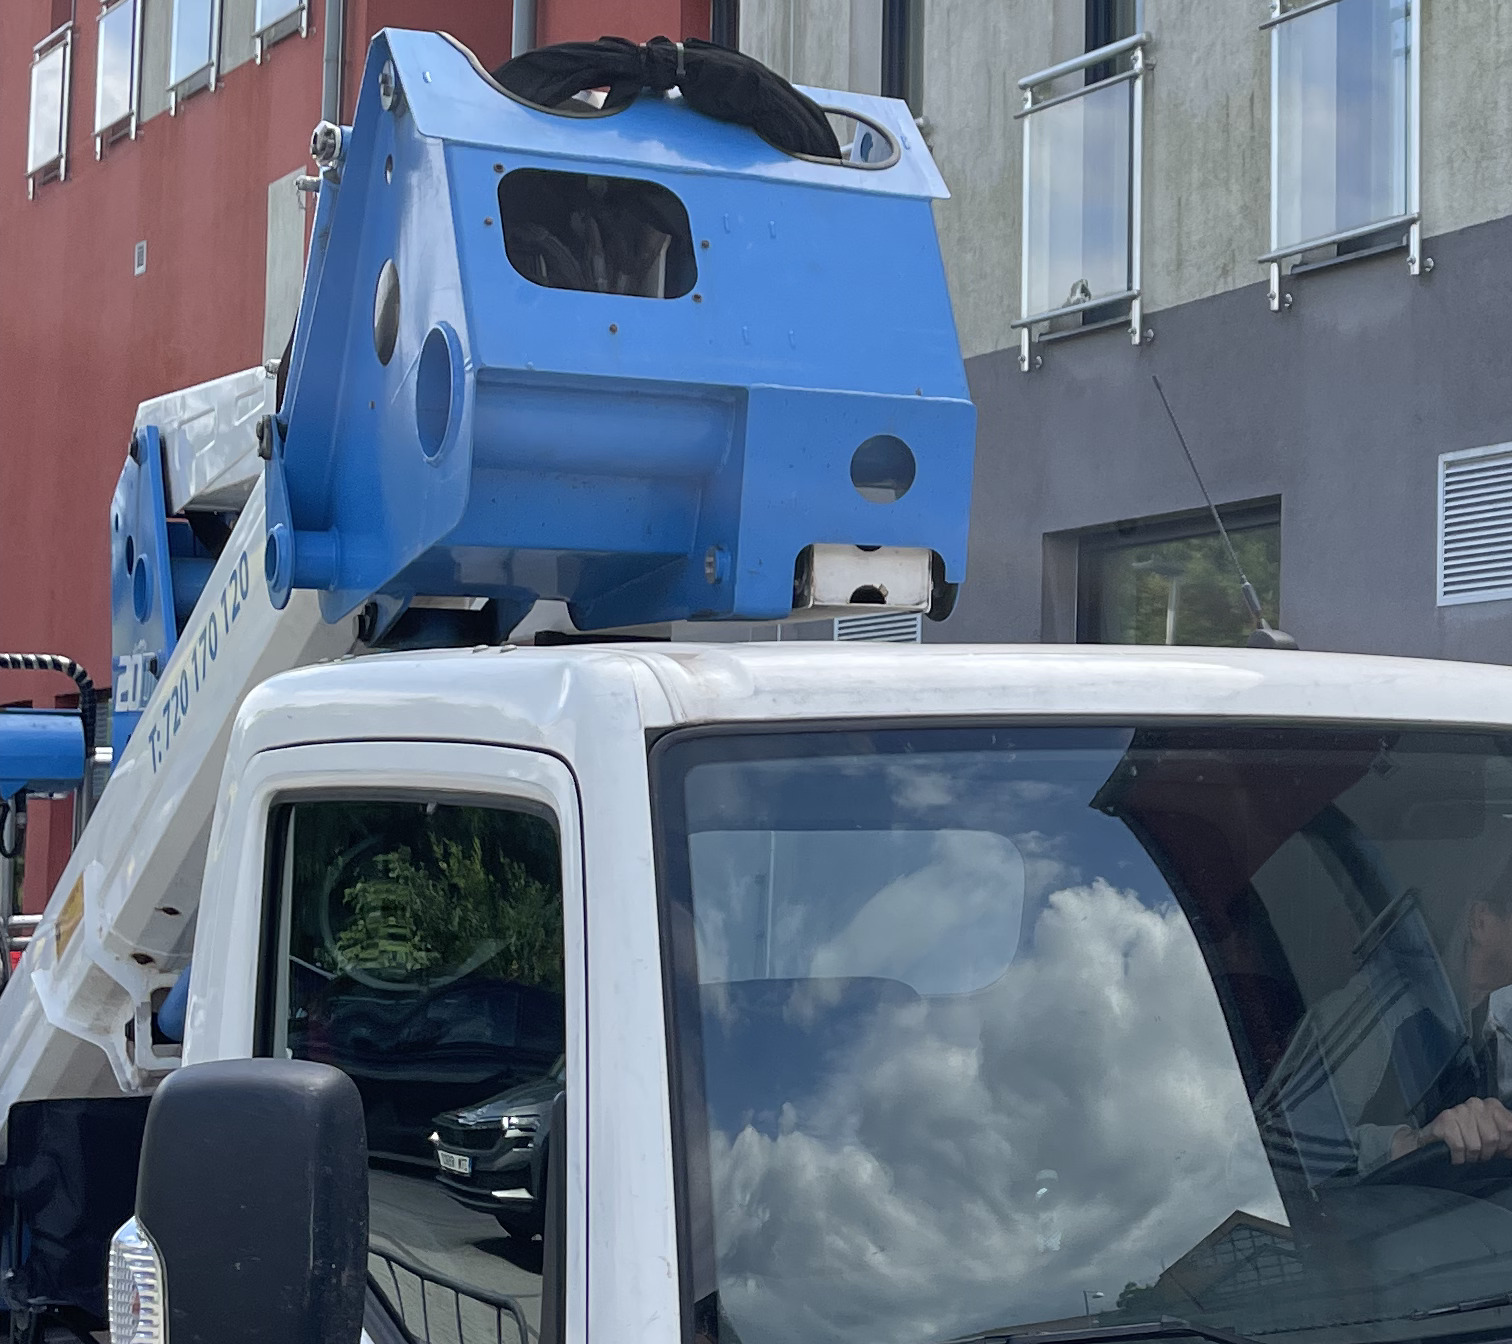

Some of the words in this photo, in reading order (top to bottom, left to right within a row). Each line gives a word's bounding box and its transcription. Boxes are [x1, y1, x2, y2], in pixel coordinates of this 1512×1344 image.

[148, 723, 162, 774] T:
[163, 668, 190, 751] 720
[192, 611, 218, 693] 170
[221, 550, 249, 635] 120
